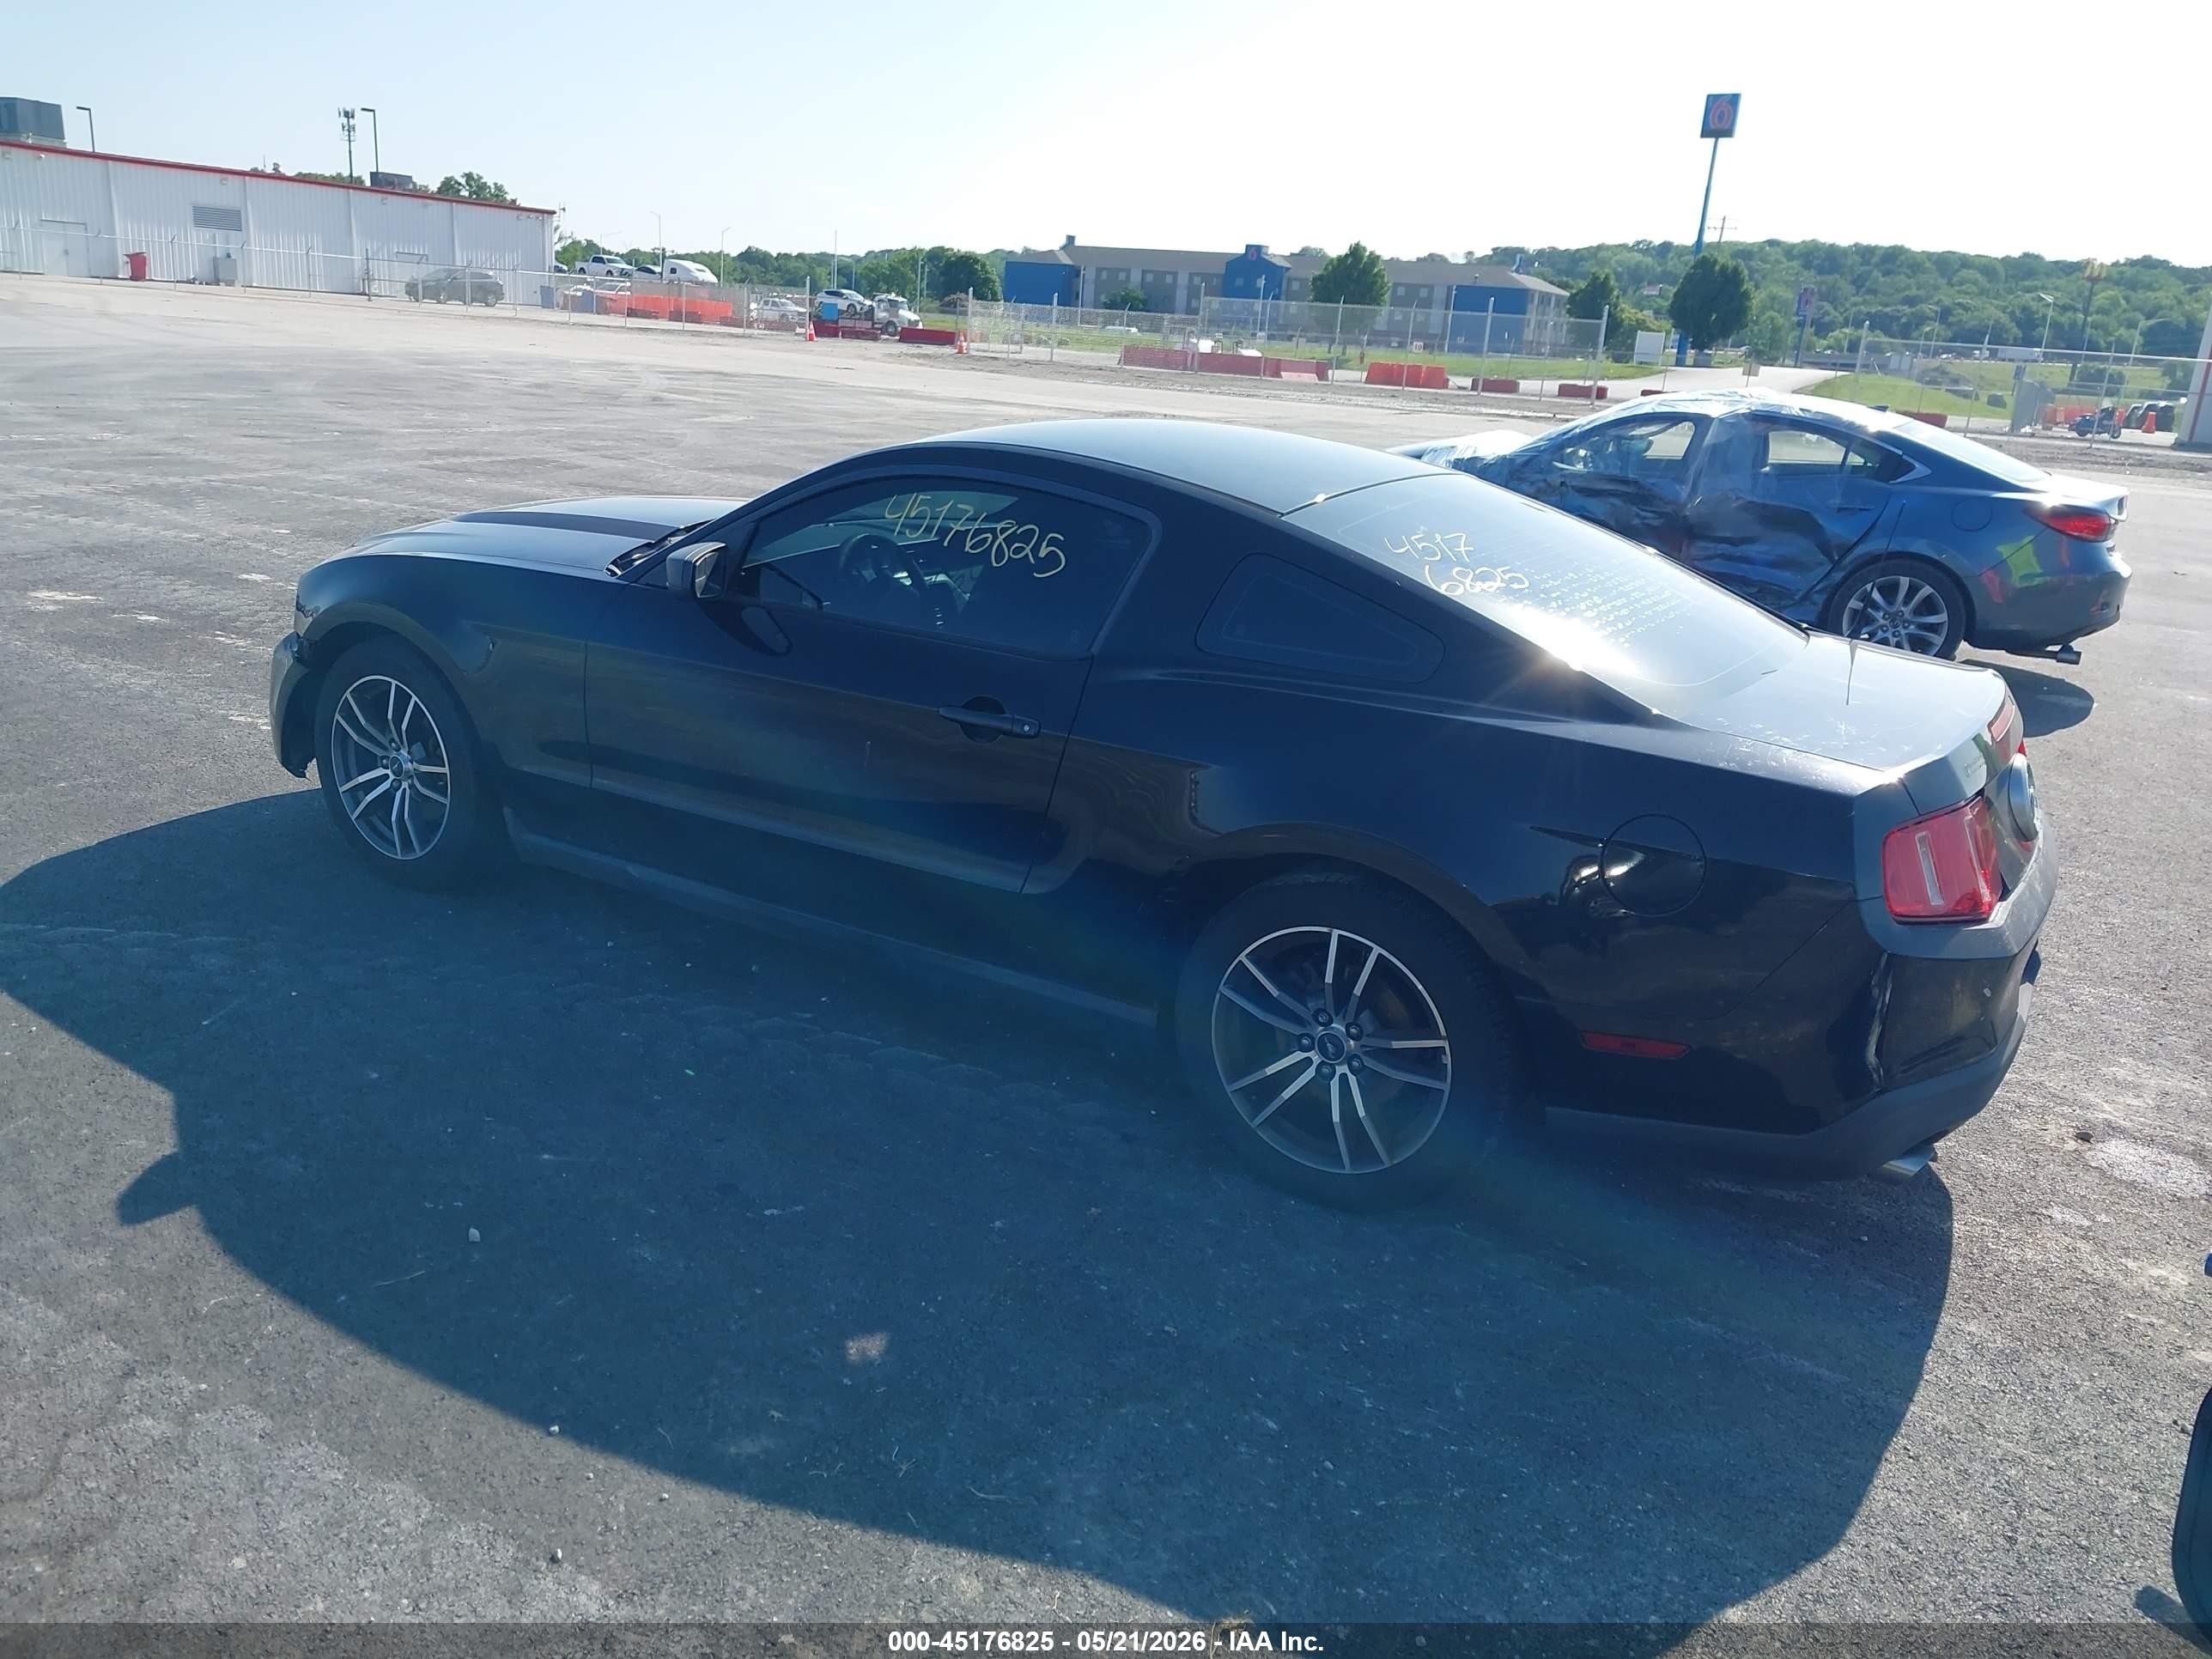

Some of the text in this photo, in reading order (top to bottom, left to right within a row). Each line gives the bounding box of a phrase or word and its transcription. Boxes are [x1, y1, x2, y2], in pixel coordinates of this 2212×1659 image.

[1711, 95, 1733, 131] 6
[884, 492, 1066, 578] 45176825
[1384, 532, 1474, 562] 4517
[1425, 564, 1529, 596] 6825
